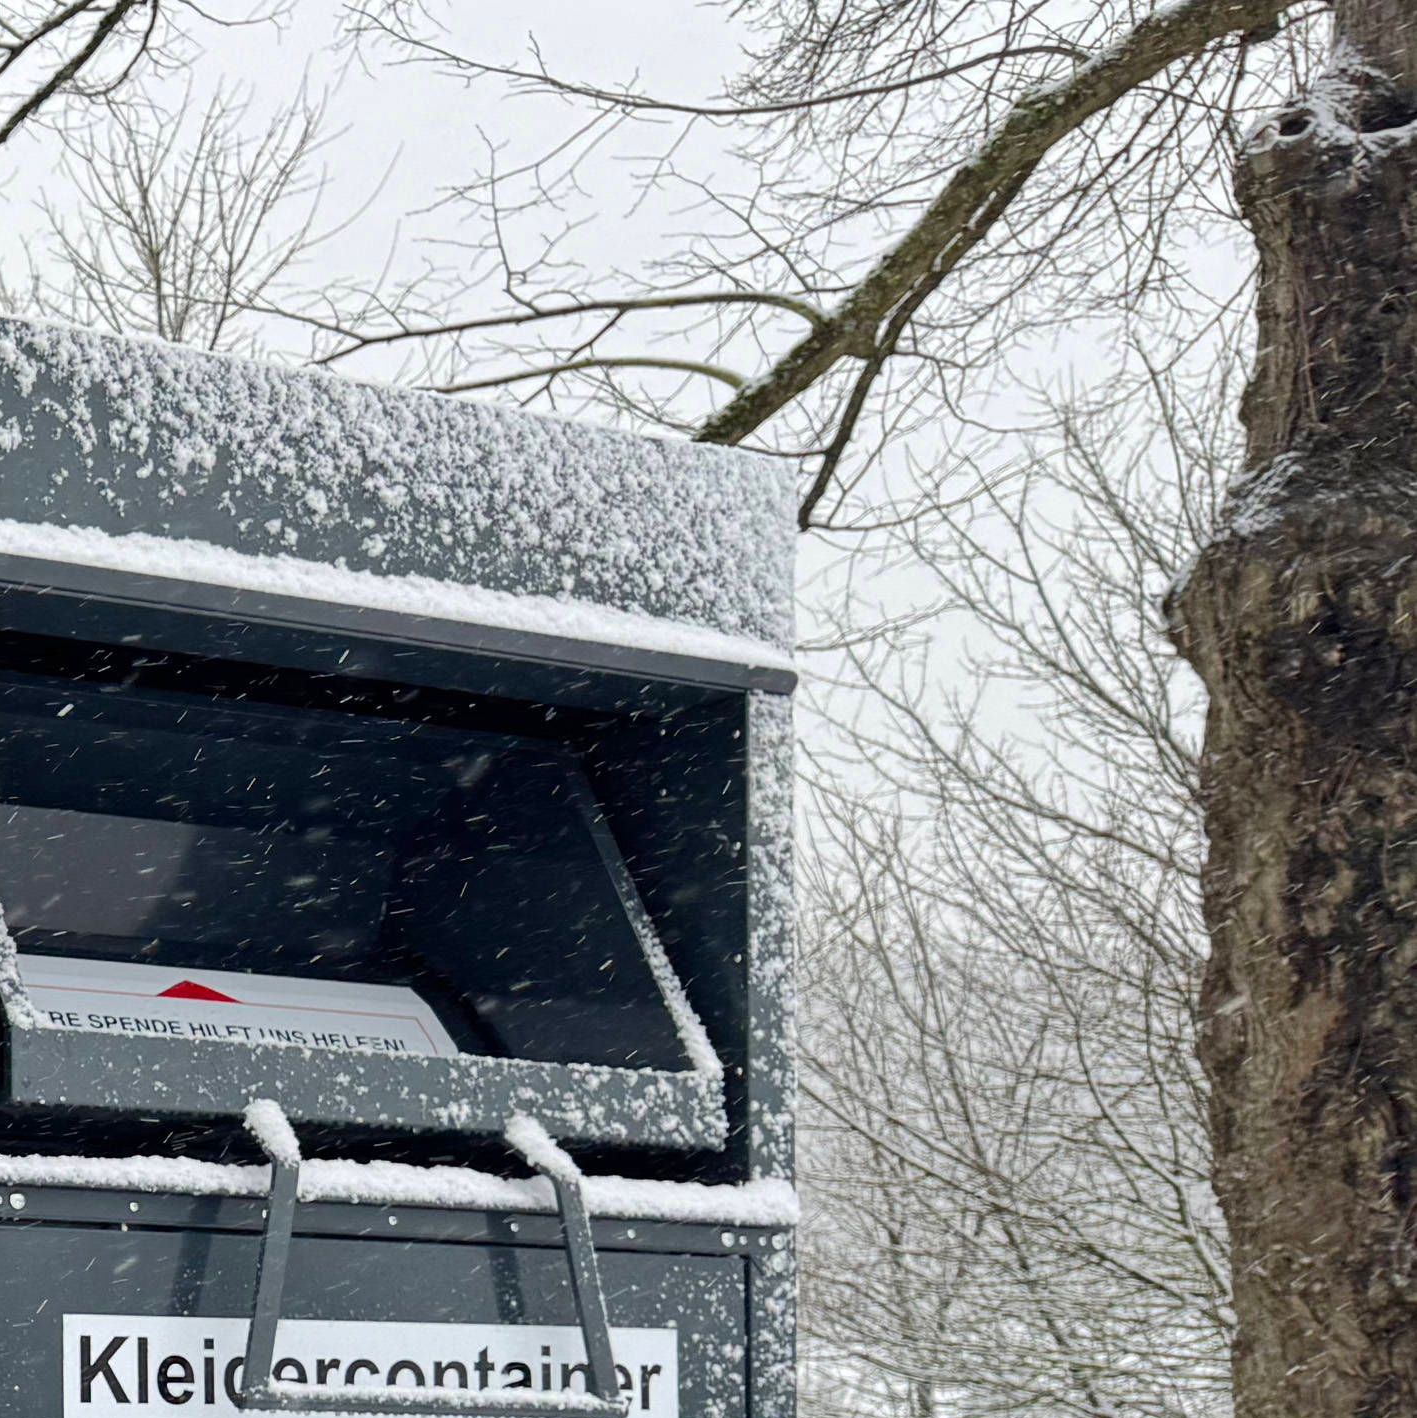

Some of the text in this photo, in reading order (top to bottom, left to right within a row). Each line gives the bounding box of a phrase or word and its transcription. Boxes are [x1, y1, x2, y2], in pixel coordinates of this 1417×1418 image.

[41, 1010, 83, 1028] RE
[87, 1013, 184, 1035] SPENDE
[188, 1021, 252, 1040] HILFT
